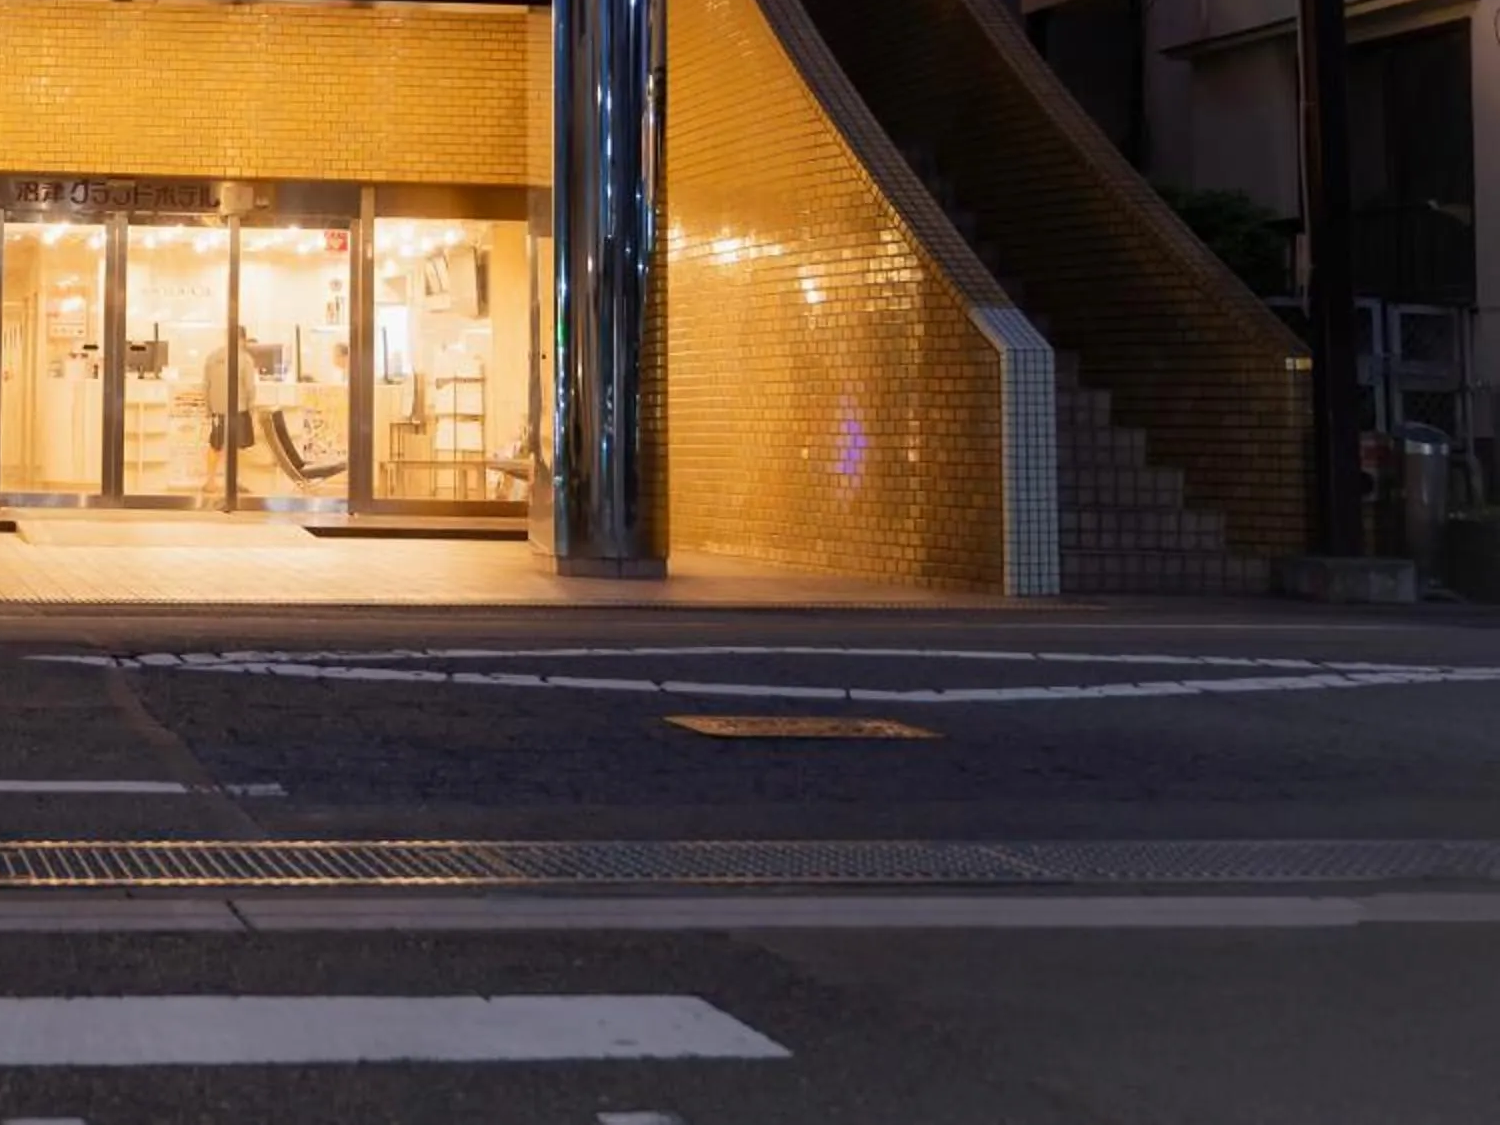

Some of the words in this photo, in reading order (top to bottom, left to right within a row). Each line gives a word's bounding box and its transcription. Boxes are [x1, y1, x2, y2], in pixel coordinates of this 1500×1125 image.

[15, 179, 221, 208] 沼津グランドホテル
